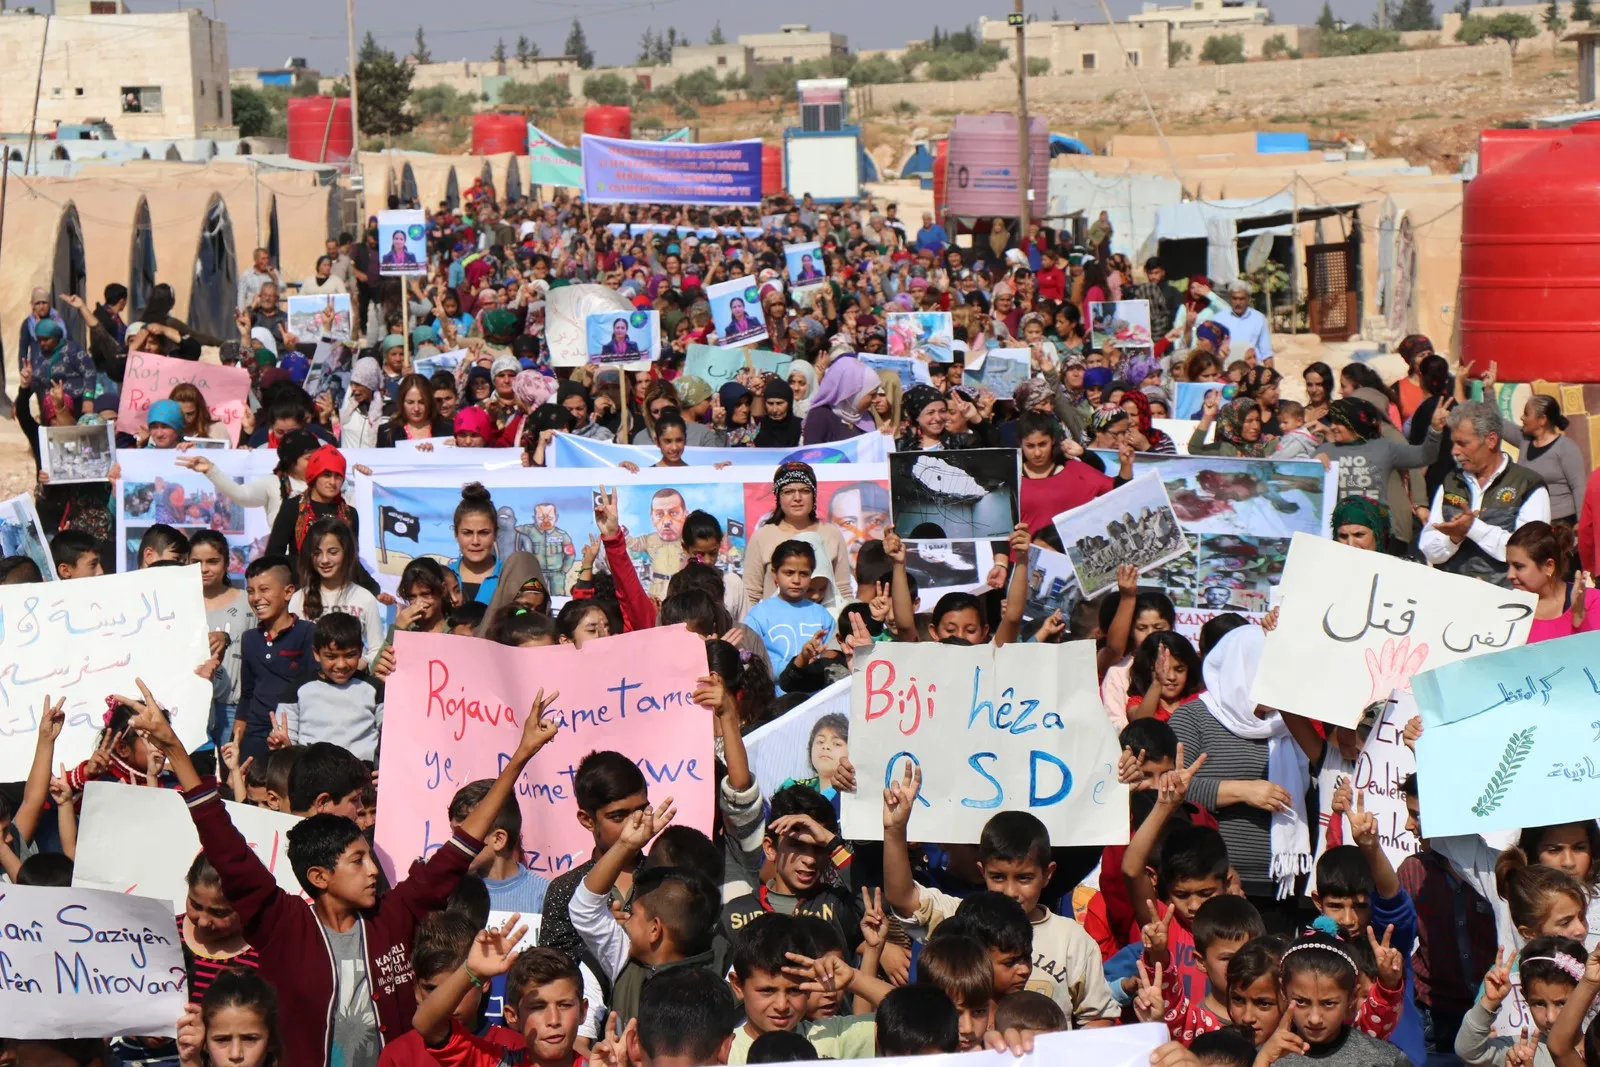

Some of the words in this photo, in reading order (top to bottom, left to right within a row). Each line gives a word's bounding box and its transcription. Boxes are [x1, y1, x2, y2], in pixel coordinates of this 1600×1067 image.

[1340, 456, 1367, 468] NO
[1322, 573, 1418, 643] قتل
[427, 659, 520, 742] Rojava
[967, 665, 1065, 735] hêza
[0, 893, 43, 944] anî
[56, 904, 171, 969] Saziyên
